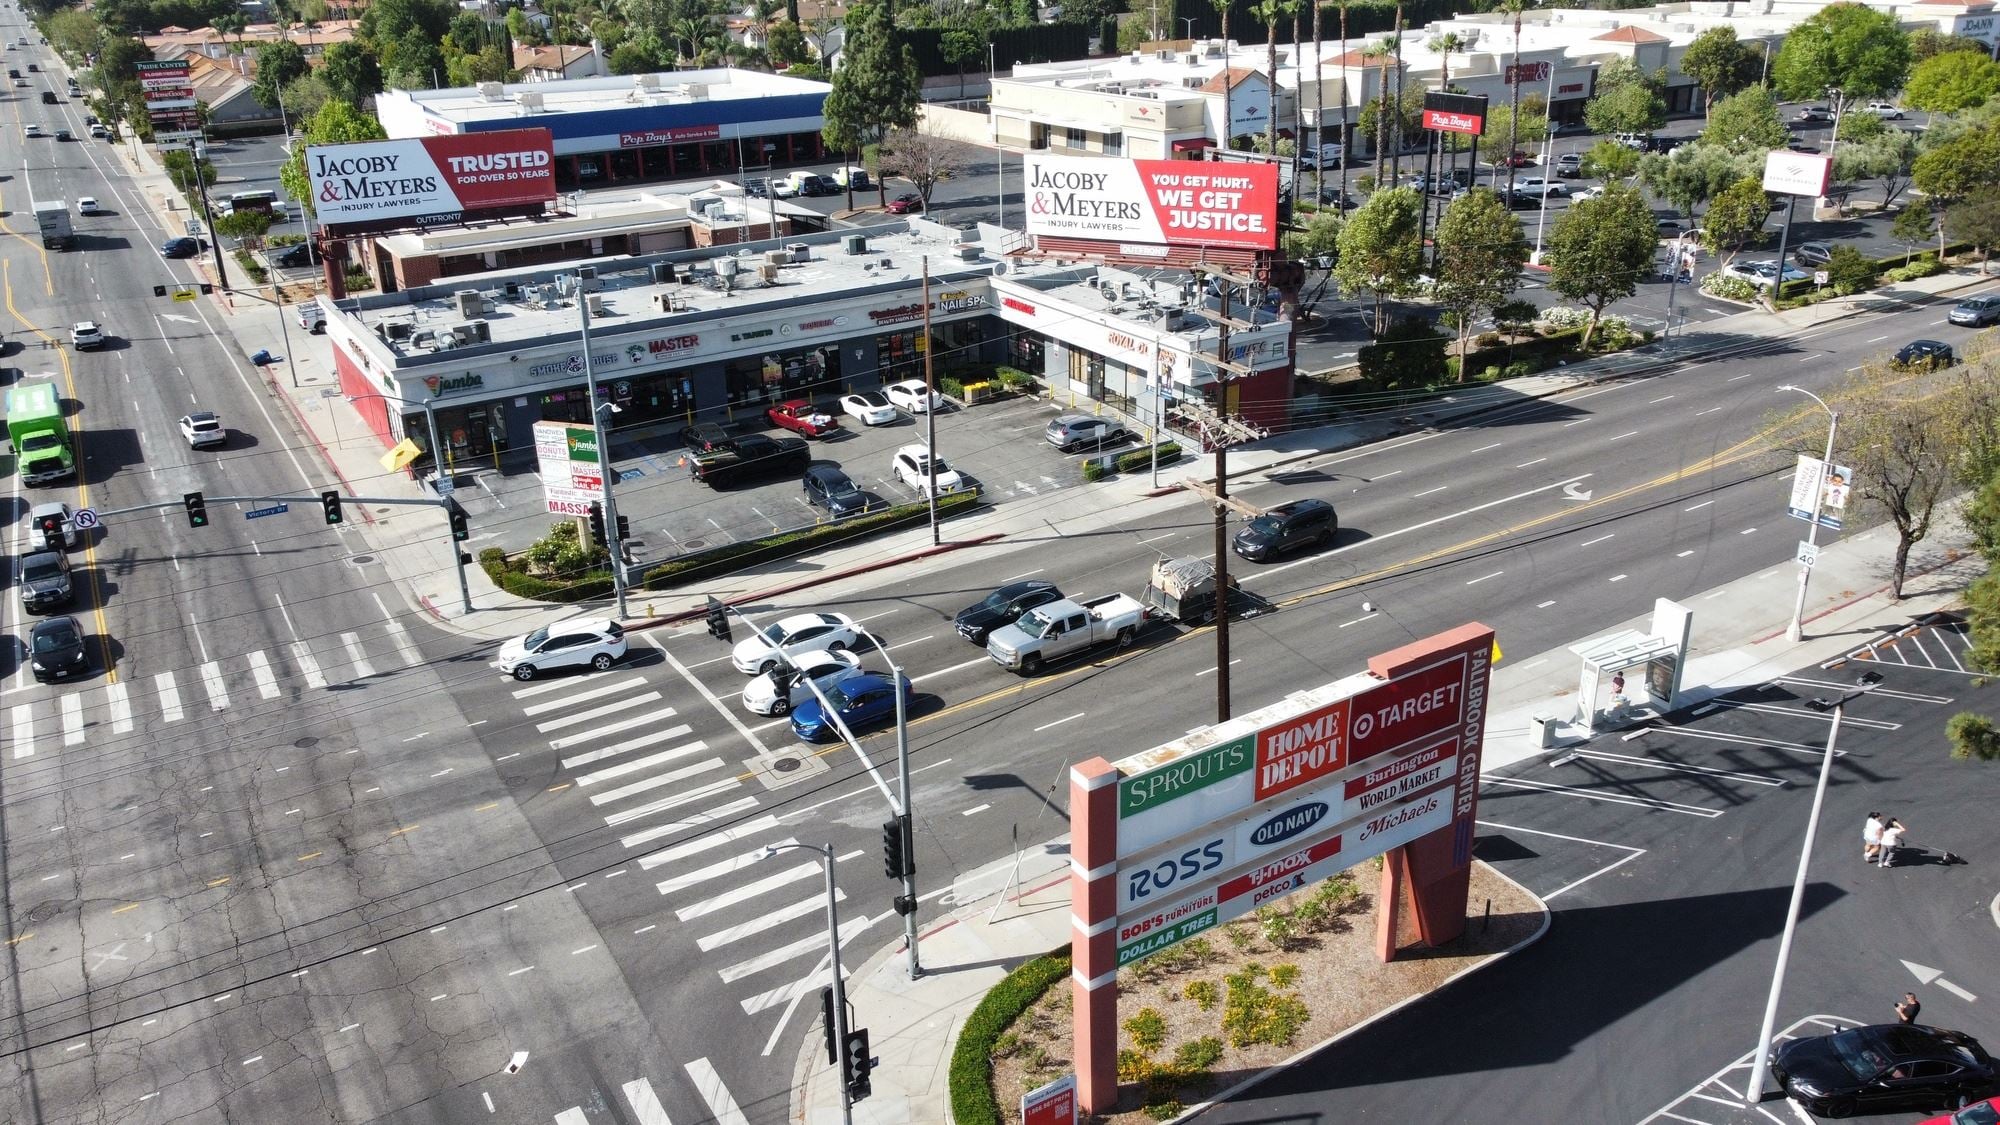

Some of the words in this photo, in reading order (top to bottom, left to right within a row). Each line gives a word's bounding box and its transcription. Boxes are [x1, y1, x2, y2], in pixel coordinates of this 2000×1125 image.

[136, 63, 160, 71] PRIDE
[160, 62, 187, 70] CENTER
[1431, 113, 1449, 126] Pep
[1449, 115, 1472, 130] Boys
[622, 134, 645, 145] Pep
[645, 132, 672, 143] Boys
[316, 154, 400, 178] JACOBY
[447, 150, 550, 174] TRUSTED
[457, 174, 474, 184] FOR
[475, 173, 505, 183] OVER
[506, 171, 518, 181] 50
[520, 169, 550, 179] YEARS
[1031, 164, 1108, 191] JACOBY
[1151, 174, 1180, 186] YOU
[1182, 176, 1209, 188] GET
[1211, 176, 1254, 190] HURT.
[341, 200, 374, 212] INJURY
[377, 198, 421, 209] LAWYERS
[1156, 189, 1194, 208] WE
[1198, 191, 1243, 210] GET
[1047, 220, 1079, 230] INJURY
[1081, 222, 1124, 231] LAWYERS
[1168, 210, 1268, 233] JUSTICE.
[940, 300, 964, 312] NAIL
[967, 295, 986, 306] SPA
[648, 335, 700, 354] MASTER
[1108, 331, 1135, 352] ROYAL
[530, 363, 568, 378] SMOKE
[438, 371, 484, 398] jamba
[537, 446, 567, 455] DONUTS
[572, 466, 601, 476] MASTER
[573, 482, 590, 490] NAIL
[249, 507, 276, 518] Victory
[1799, 555, 1814, 566] 40
[1377, 680, 1460, 729] TARGET
[1463, 647, 1488, 750] FALLBROOK
[1267, 710, 1340, 762] HOME
[1128, 742, 1246, 808] SPROUTS
[1261, 736, 1342, 791] DEPOT
[1365, 749, 1439, 788] Burlington
[1360, 785, 1397, 811] WORLD
[1399, 766, 1441, 795] MARKET
[1456, 752, 1476, 817] CENTER
[1256, 820, 1284, 844] OLD
[1285, 805, 1322, 832] NAVY
[1359, 797, 1438, 842] Michaels
[1129, 838, 1224, 902] ROSS
[1253, 879, 1290, 906] petco
[1121, 914, 1164, 942] BOB'S
[1165, 895, 1214, 922] FURNITURE
[1119, 930, 1176, 963] DOLLAR
[1180, 912, 1215, 936] TREE
